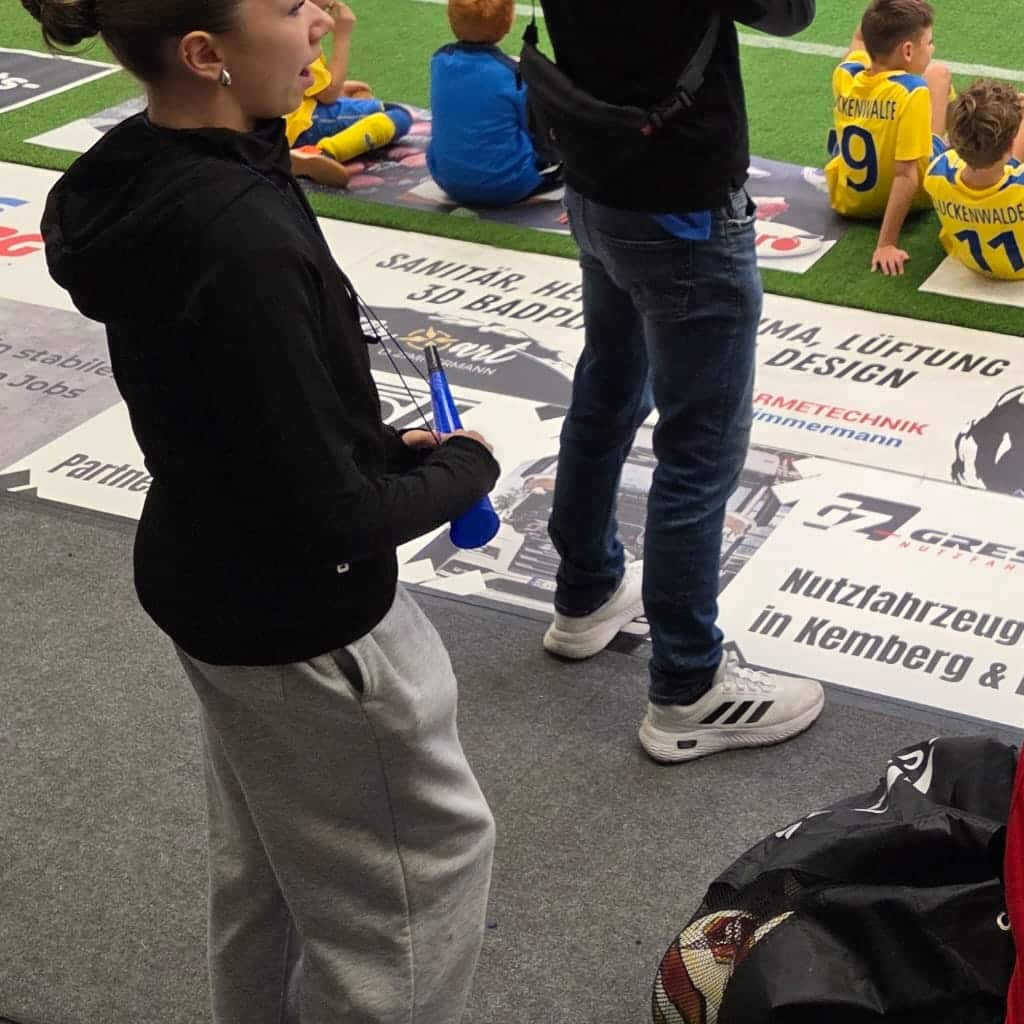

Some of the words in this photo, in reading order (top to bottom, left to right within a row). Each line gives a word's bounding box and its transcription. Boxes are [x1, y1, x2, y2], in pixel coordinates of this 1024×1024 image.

[841, 125, 878, 193] 9
[376, 252, 527, 294] SANITÄR,
[531, 280, 583, 302] HE
[406, 283, 466, 306] 3D
[12, 348, 114, 377] stabile
[758, 318, 823, 348] MA,
[838, 333, 1012, 378] LÜFTUNG
[764, 347, 919, 390] DESIGN
[7, 374, 87, 399] Jobs
[752, 392, 932, 437] RMETECHNIK
[752, 408, 904, 449] immermann
[747, 604, 793, 638] in
[793, 615, 975, 684] Kemberg
[977, 661, 1008, 690] &
